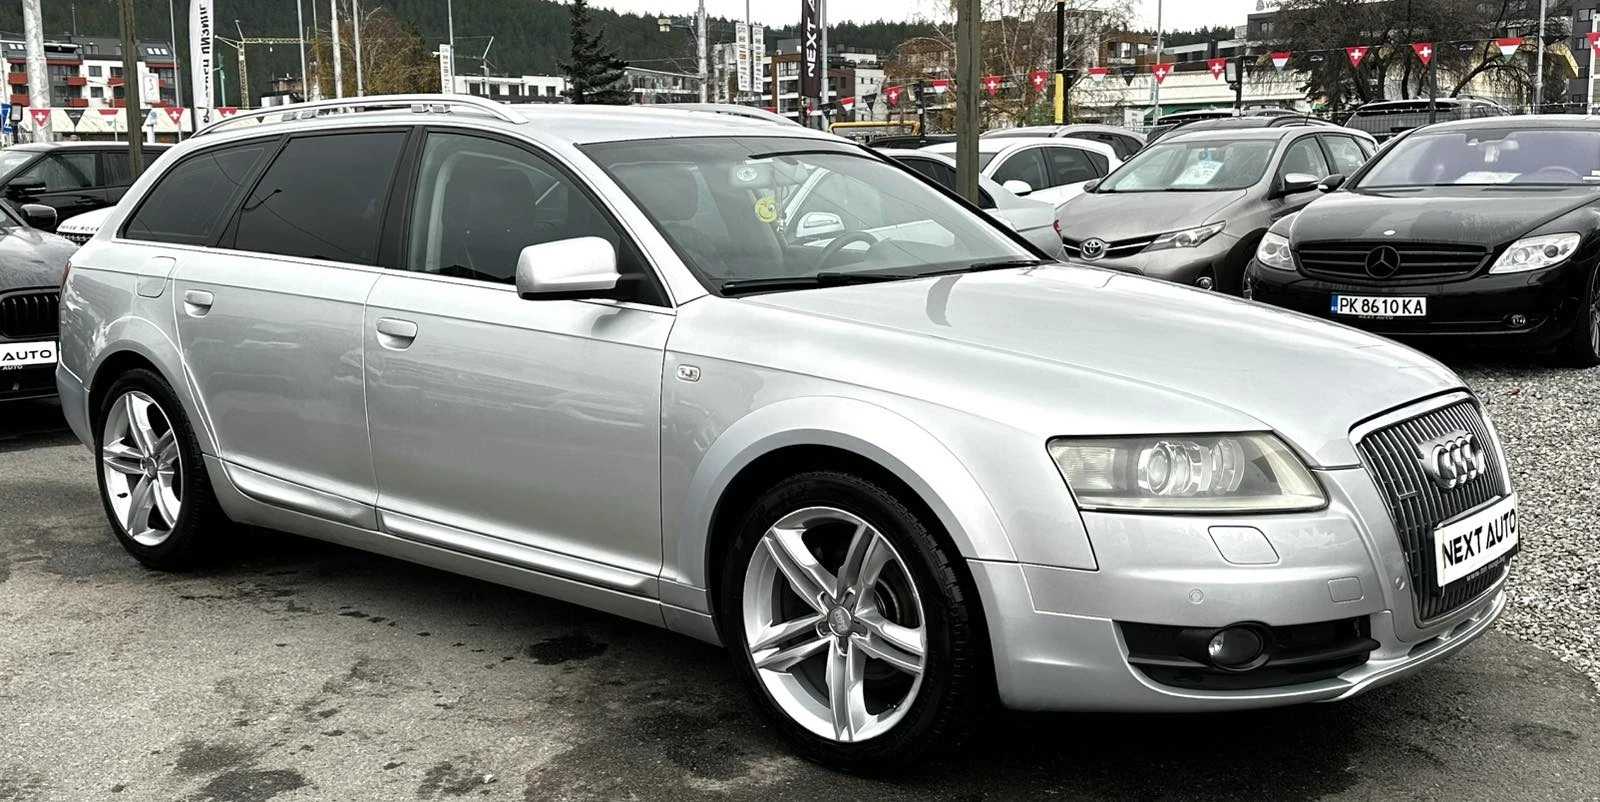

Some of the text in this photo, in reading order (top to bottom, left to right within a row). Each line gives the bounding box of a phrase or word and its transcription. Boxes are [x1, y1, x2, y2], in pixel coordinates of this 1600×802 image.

[806, 16, 817, 77] NEXT
[1340, 297, 1358, 313] PK
[1361, 298, 1399, 314] 8610
[1402, 299, 1423, 314] KA
[2, 349, 52, 361] AUTO
[1442, 525, 1483, 569] NEXT
[1486, 508, 1516, 549] AUTO
